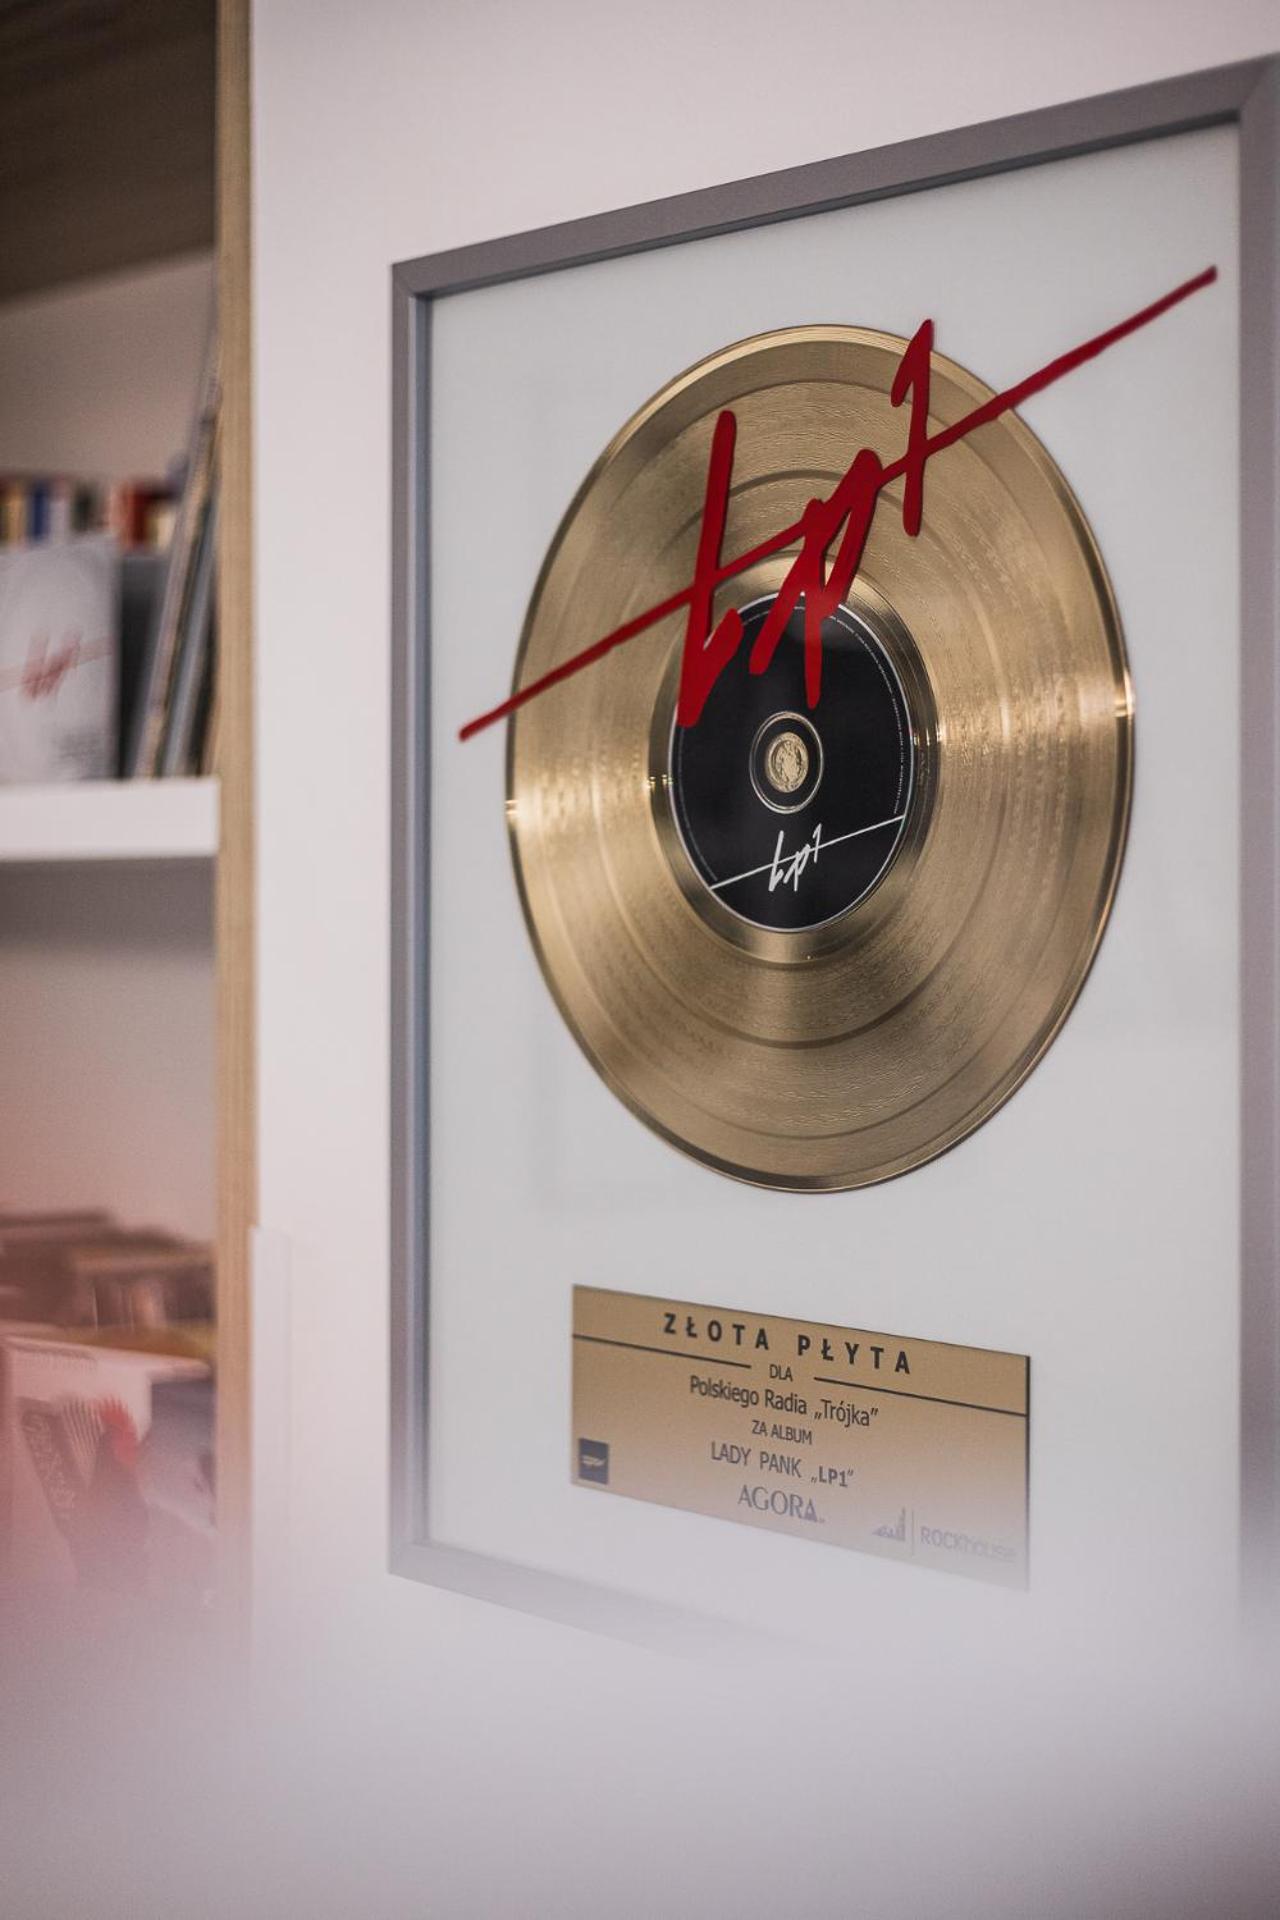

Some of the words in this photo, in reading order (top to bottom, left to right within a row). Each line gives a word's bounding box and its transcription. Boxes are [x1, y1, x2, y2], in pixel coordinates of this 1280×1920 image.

[664, 1312, 769, 1350] ZŁOTA
[797, 1334, 911, 1374] PŁYTA
[769, 1363, 793, 1382] DLA
[690, 1375, 759, 1407] Polskiego
[764, 1390, 808, 1415] Radia
[751, 1419, 768, 1437] ZA
[770, 1424, 813, 1445] ALBUM
[711, 1441, 751, 1467] LADY
[759, 1451, 801, 1478] PANK
[737, 1484, 819, 1523] AGORA
